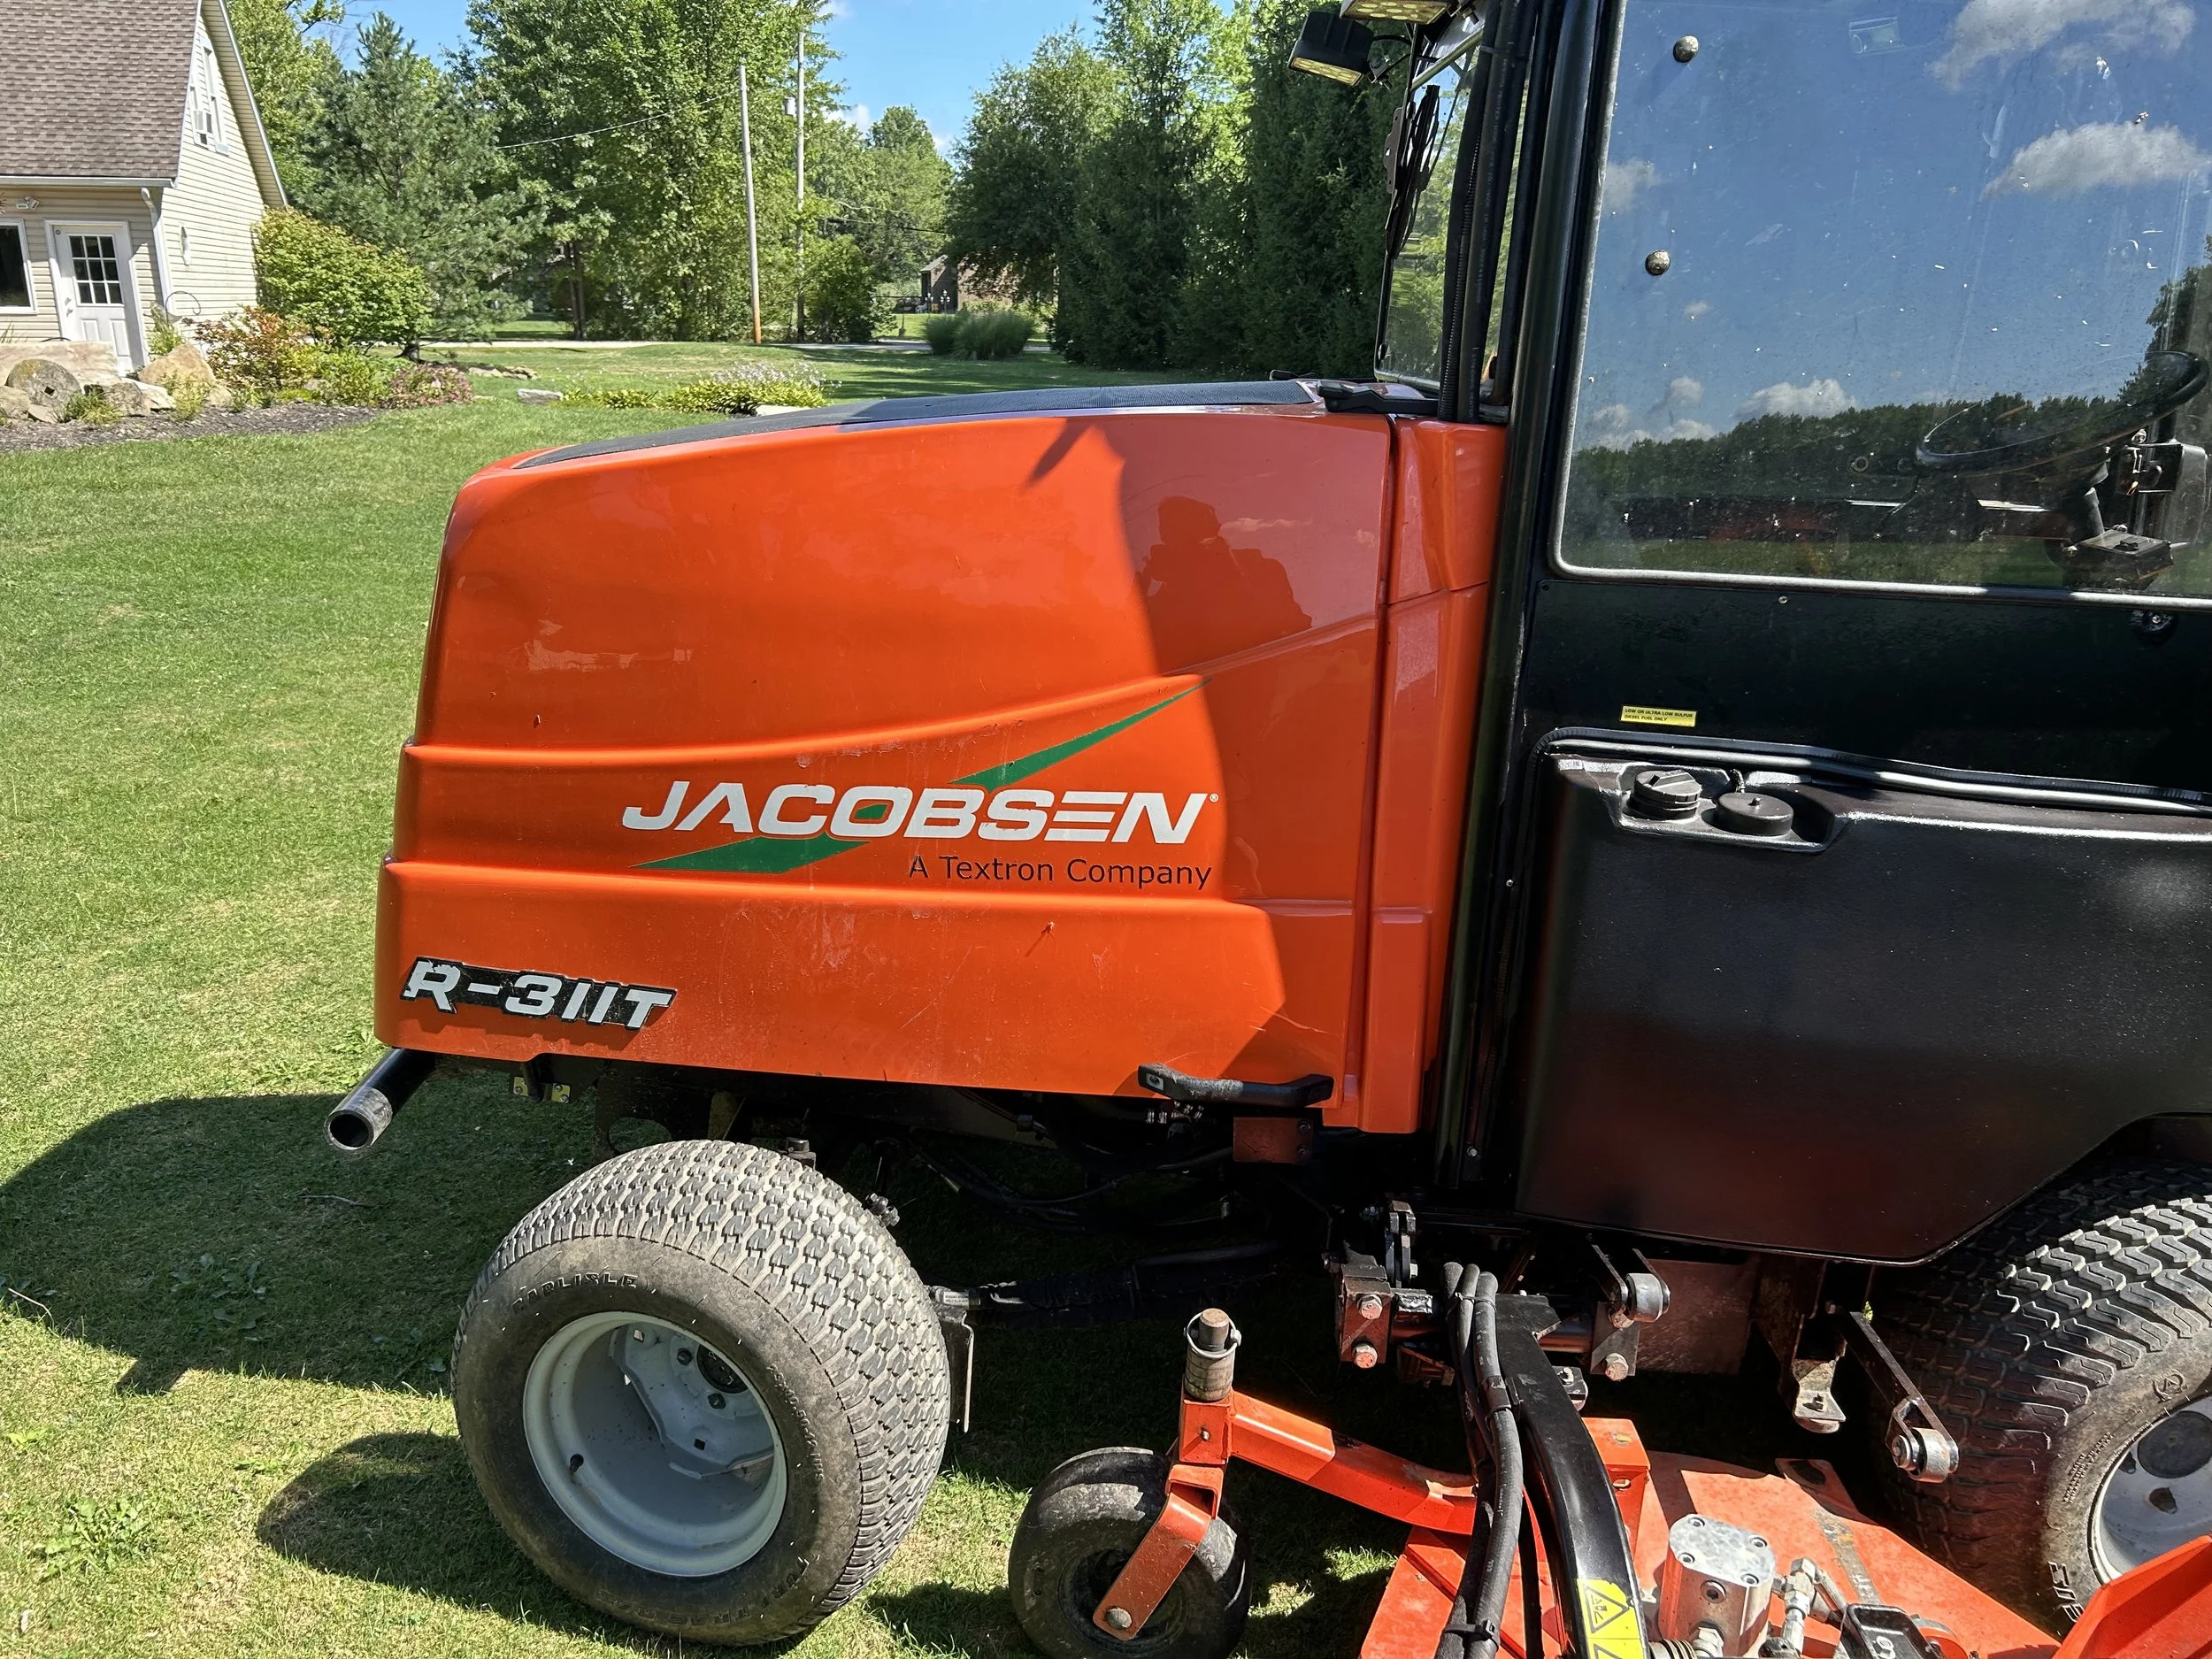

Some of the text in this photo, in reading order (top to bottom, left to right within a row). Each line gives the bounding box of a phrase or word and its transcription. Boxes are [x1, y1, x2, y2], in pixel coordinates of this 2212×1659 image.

[622, 780, 1208, 844] JACOBSEN
[908, 855, 1212, 890] A Textron Company
[403, 958, 673, 1029] R-311T
[511, 1271, 638, 1315] CARLISLE
